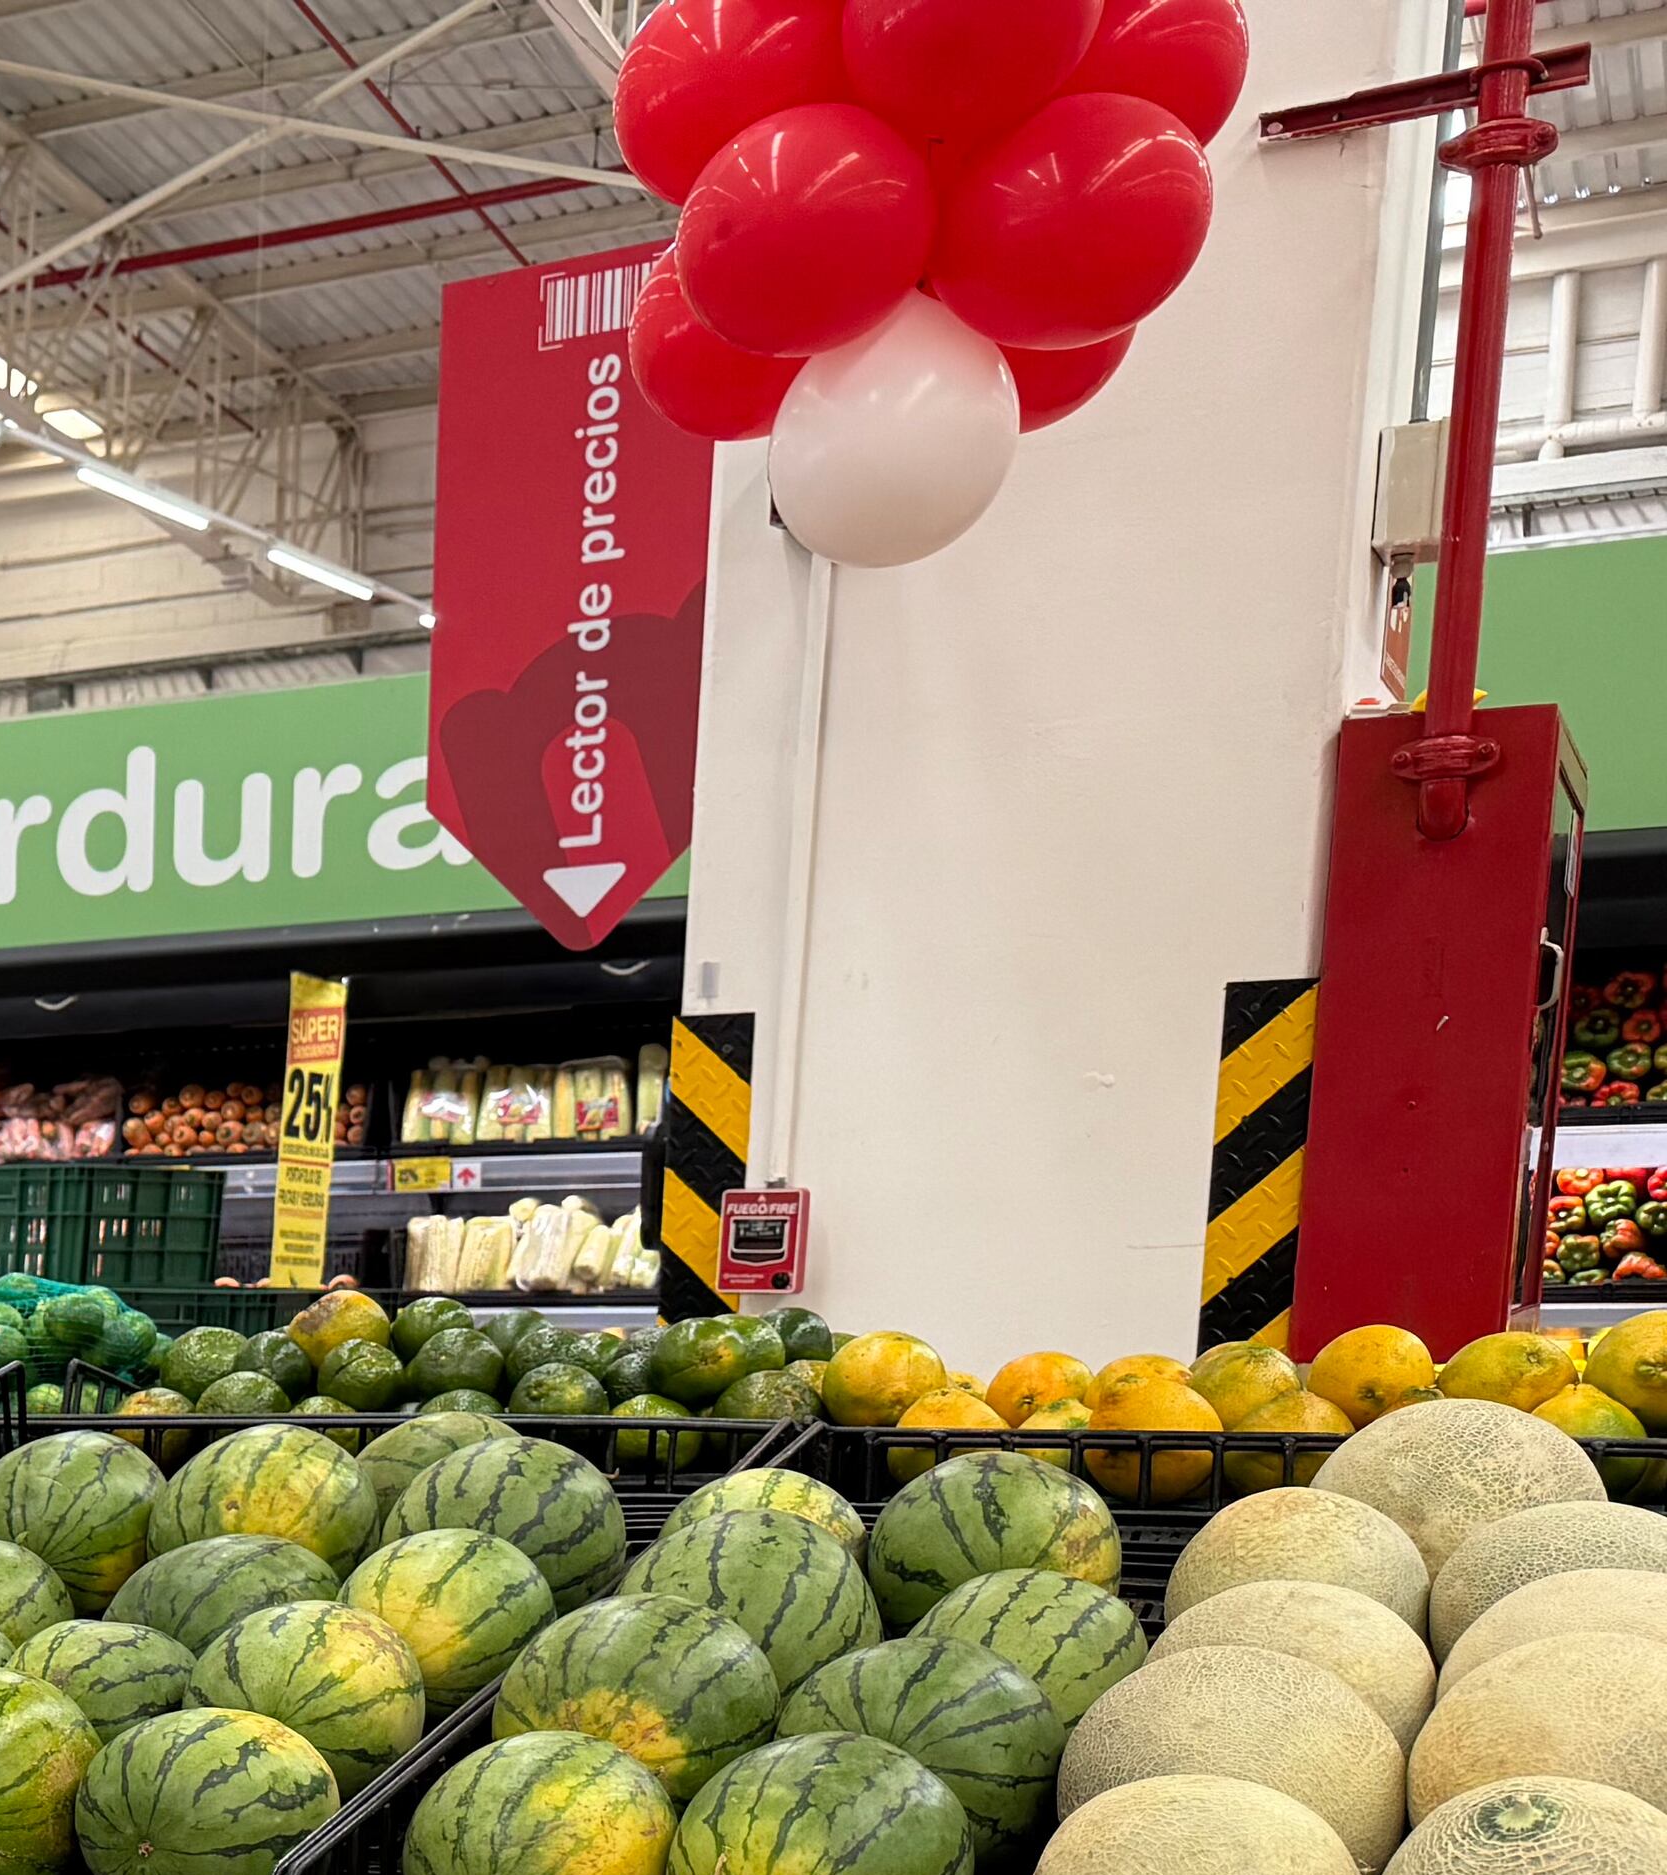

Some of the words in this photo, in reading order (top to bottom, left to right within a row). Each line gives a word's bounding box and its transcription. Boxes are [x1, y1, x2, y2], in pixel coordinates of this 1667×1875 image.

[575, 354, 625, 563] precios
[568, 583, 612, 652] de
[559, 668, 608, 847] Lector
[292, 1015, 340, 1044] SUPER
[727, 1203, 767, 1215] FUEGO
[769, 1203, 798, 1214] FIRE
